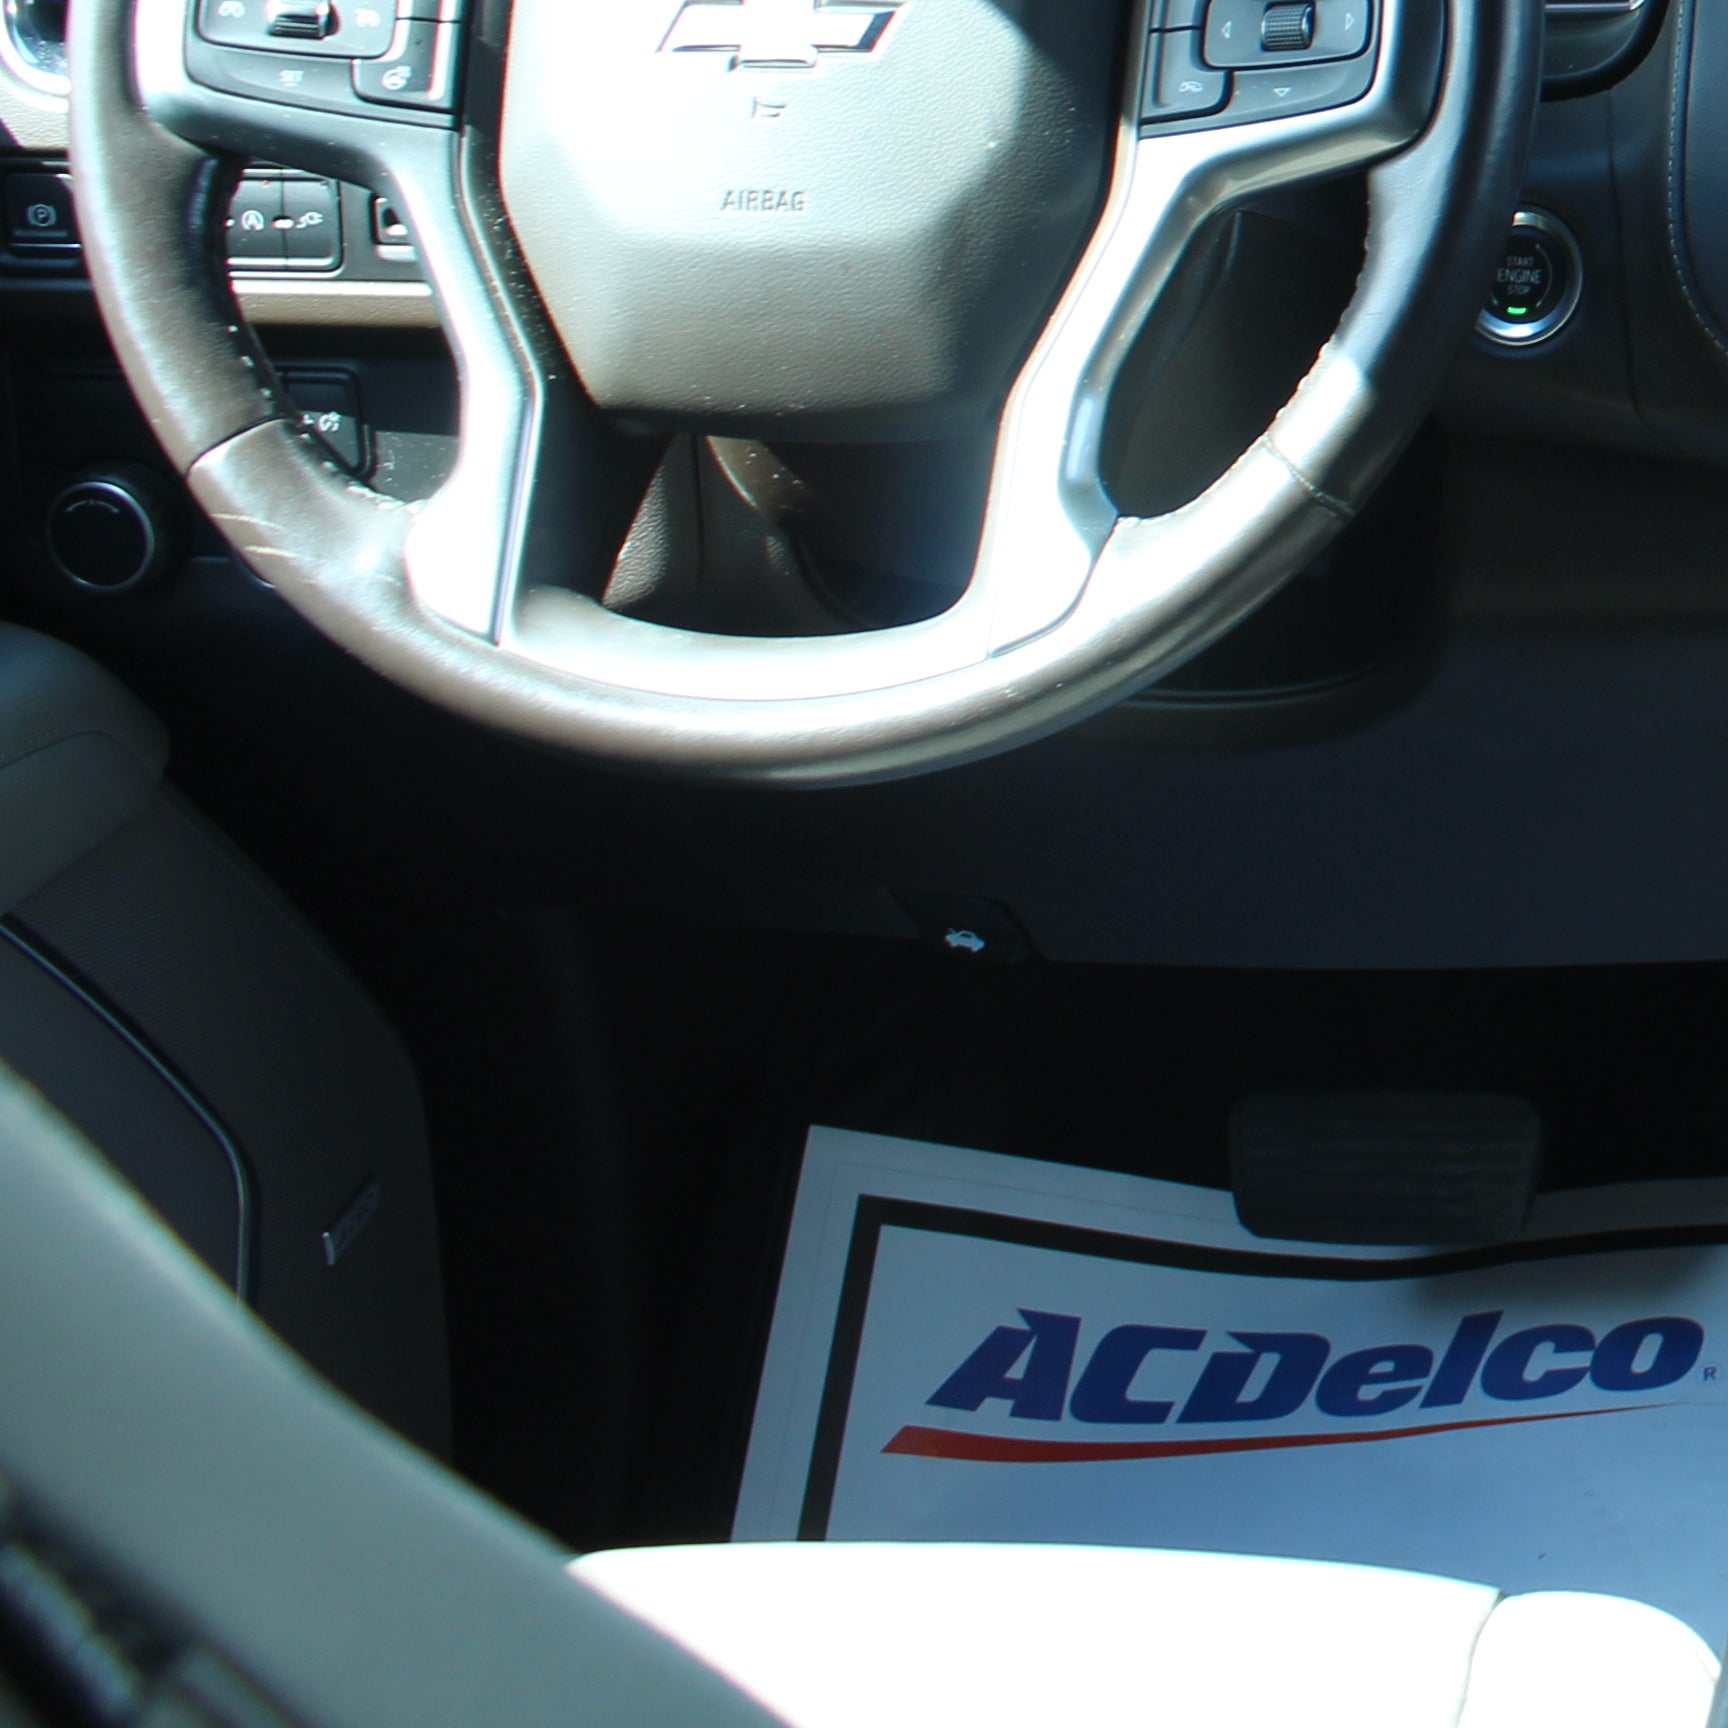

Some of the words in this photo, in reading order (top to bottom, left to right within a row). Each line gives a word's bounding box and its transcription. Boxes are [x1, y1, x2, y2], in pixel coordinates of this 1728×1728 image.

[720, 188, 806, 212] AIRBAG
[1506, 255, 1535, 267] START
[1496, 267, 1544, 284] ENGINE
[1506, 284, 1532, 296] STOP
[925, 1307, 1706, 1425] ACDelco
